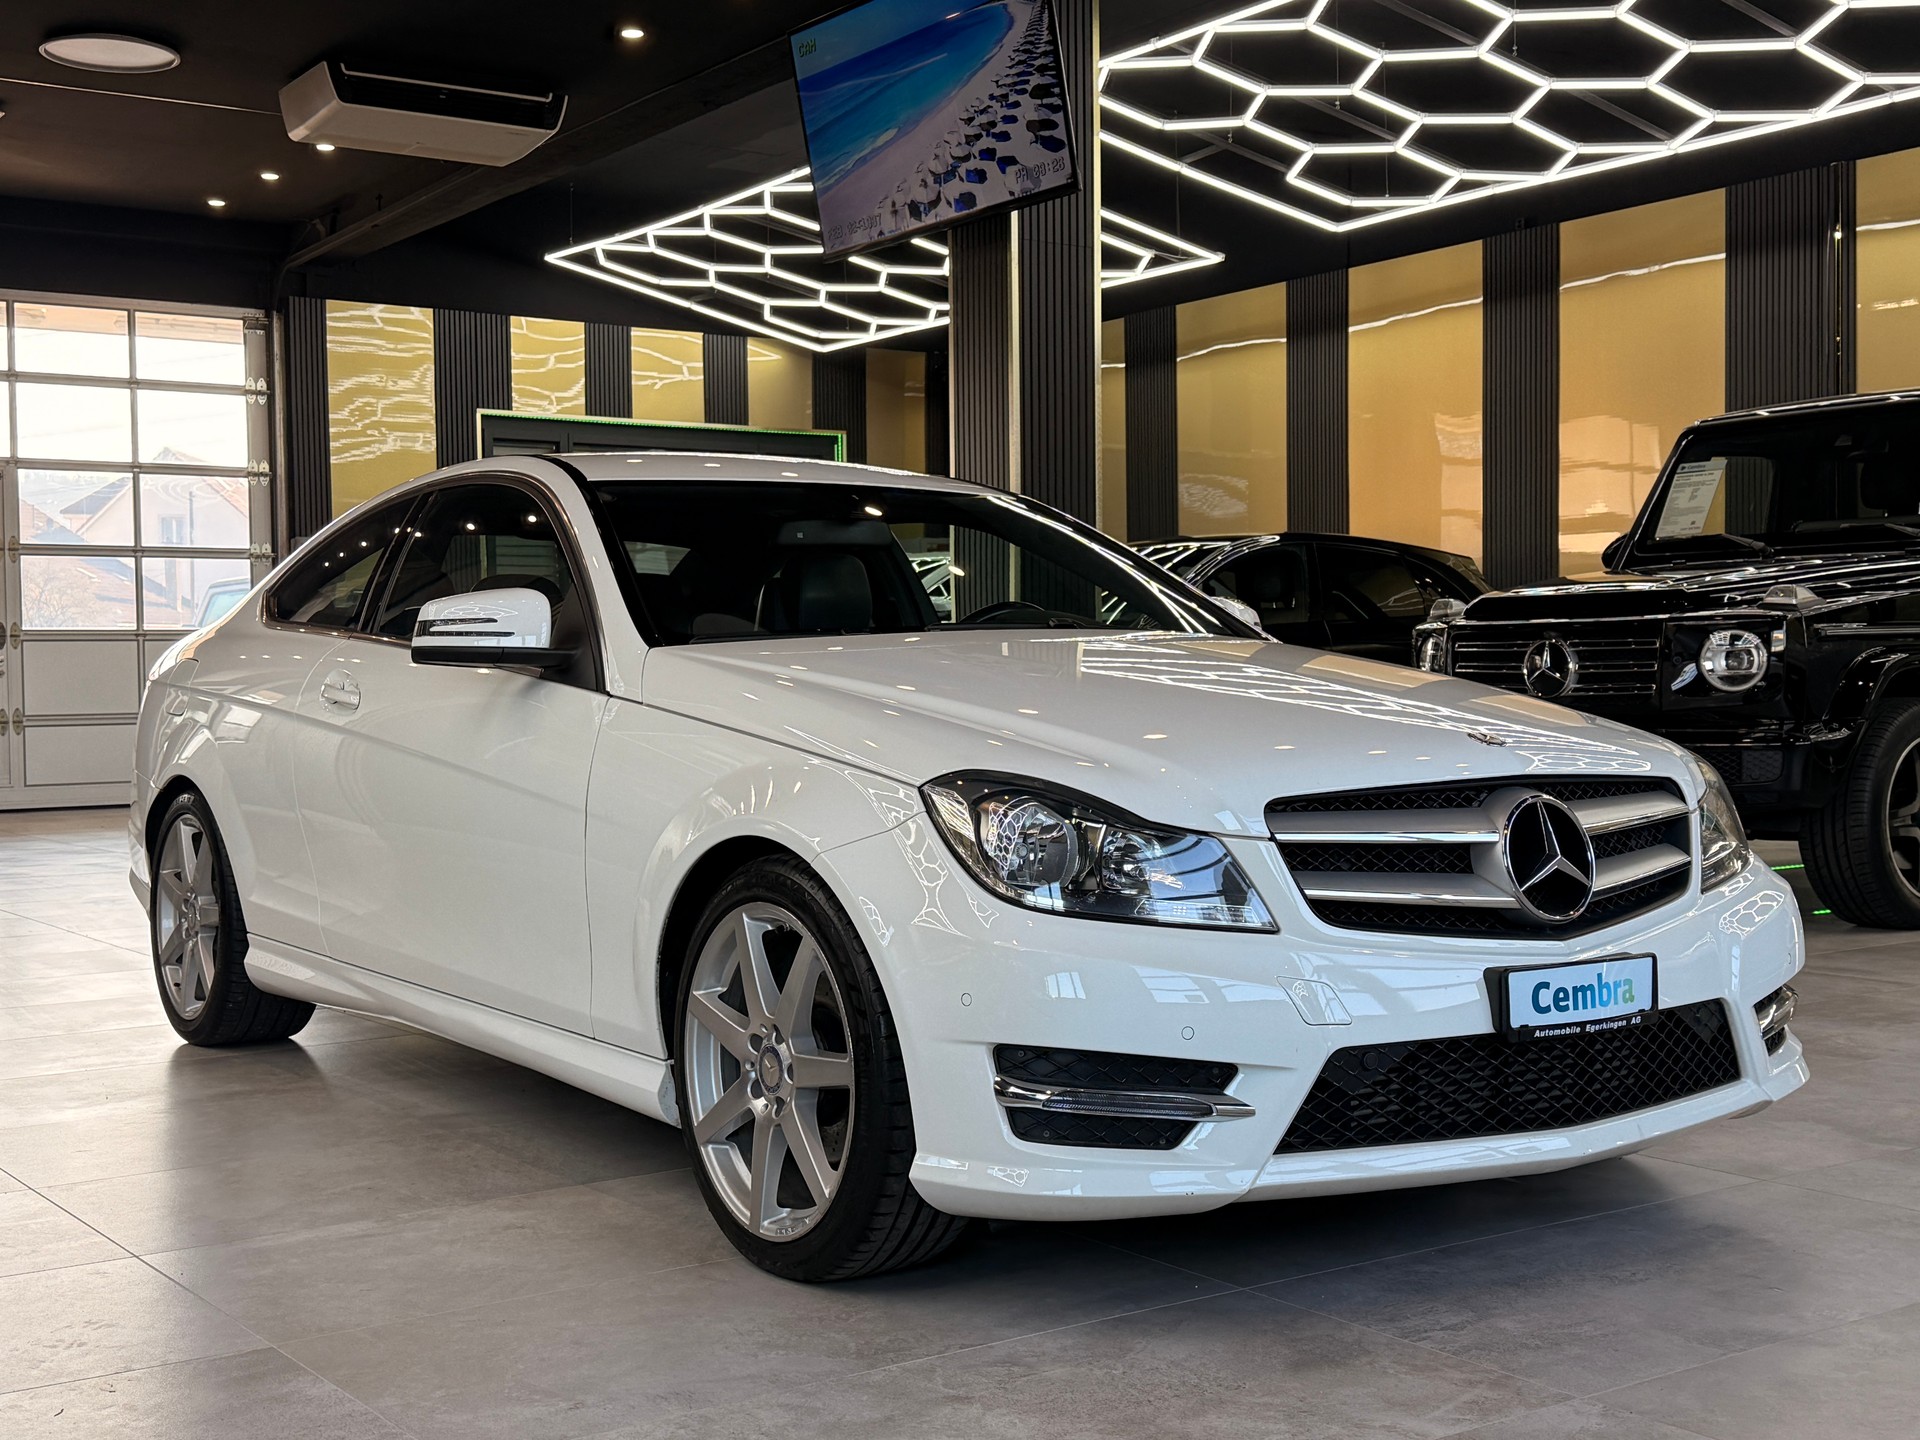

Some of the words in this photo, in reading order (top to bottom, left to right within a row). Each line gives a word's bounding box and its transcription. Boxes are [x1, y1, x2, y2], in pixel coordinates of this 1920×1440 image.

[1531, 972, 1635, 1015] Cembra
[1534, 1026, 1581, 1038] Automobile
[1585, 1019, 1627, 1033] Egerkingen
[1631, 1016, 1641, 1025] AG
